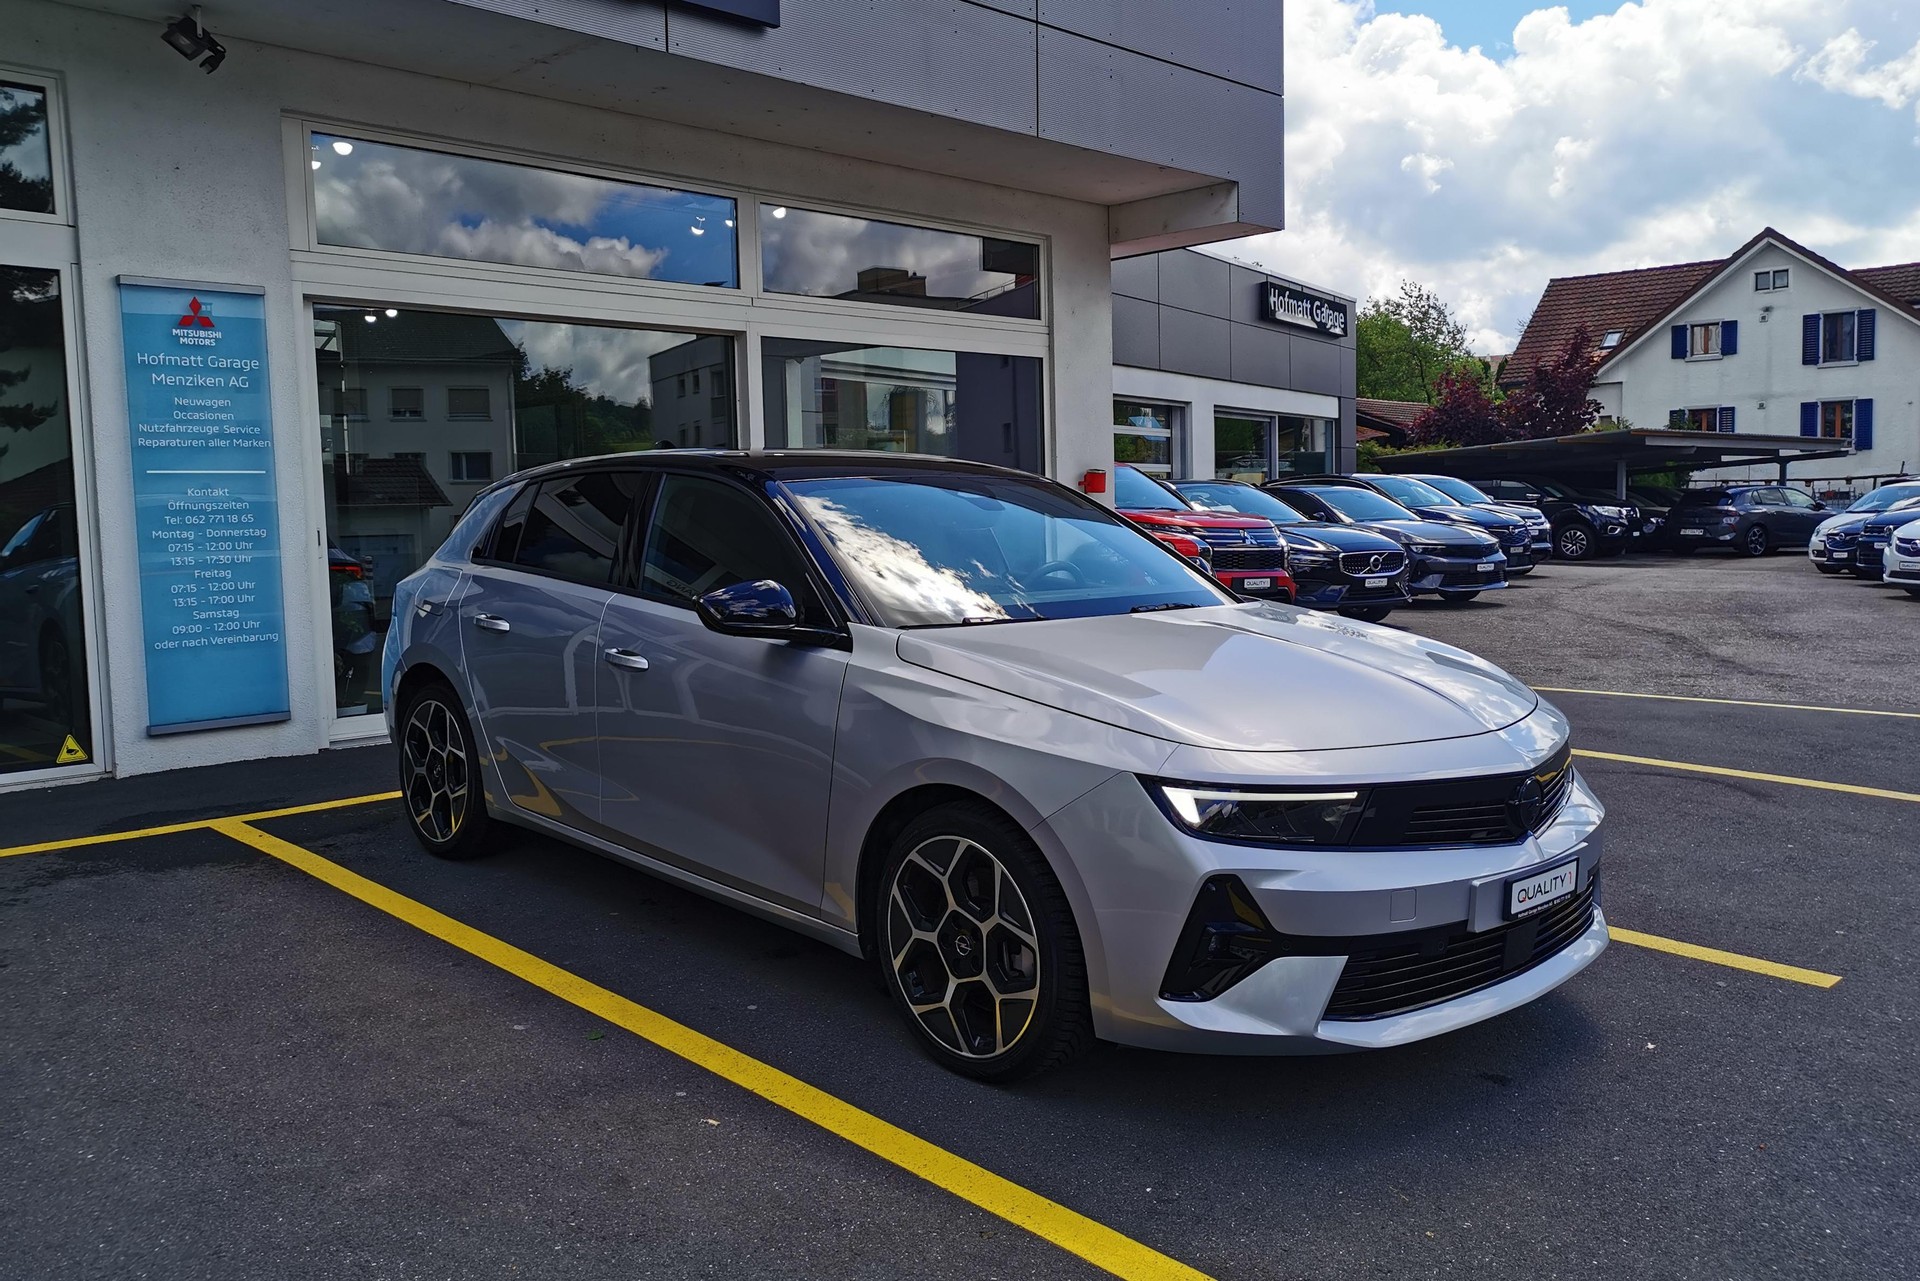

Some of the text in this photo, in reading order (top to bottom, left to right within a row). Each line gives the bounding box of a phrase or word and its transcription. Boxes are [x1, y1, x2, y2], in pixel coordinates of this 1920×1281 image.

[1270, 288, 1345, 329] Hofmatt Garage
[172, 329, 222, 339] MITSUBISHI
[180, 338, 216, 346] MOTORS
[137, 353, 259, 371] Hofmatt Garage
[152, 373, 249, 388] Menziken AG
[174, 397, 231, 408] Neuwagen
[173, 411, 234, 420] Occasionen
[139, 424, 260, 434] Nutzfahrzeuge Service
[138, 438, 271, 448] Reparaturen aller Marken
[187, 488, 229, 497] Kontakt
[168, 501, 249, 512] Öffnungszeiten
[165, 514, 254, 525] Tel: 062 771 18 65
[152, 530, 194, 540] Montag
[206, 528, 267, 538] Donnerstag
[168, 543, 194, 552] 07:15
[206, 542, 232, 551] 12:00
[235, 541, 253, 549] Uhr
[171, 557, 195, 566] 13:15
[206, 555, 231, 564] 17:30
[234, 554, 252, 562] Uhr
[194, 569, 232, 579] Freitag
[171, 584, 197, 593] 07:15
[208, 582, 235, 591] 12:00
[237, 581, 256, 589] Uhr
[173, 598, 197, 607] 13:15
[208, 596, 234, 604] 17:00
[237, 594, 255, 602] Uhr
[193, 609, 240, 619] Samstag
[172, 624, 202, 634] 09:00
[214, 622, 240, 632] 12:00
[242, 620, 261, 629] Uhr
[154, 632, 279, 650] oder nach Vereinbarung
[1518, 872, 1572, 903] QUALITY 1
